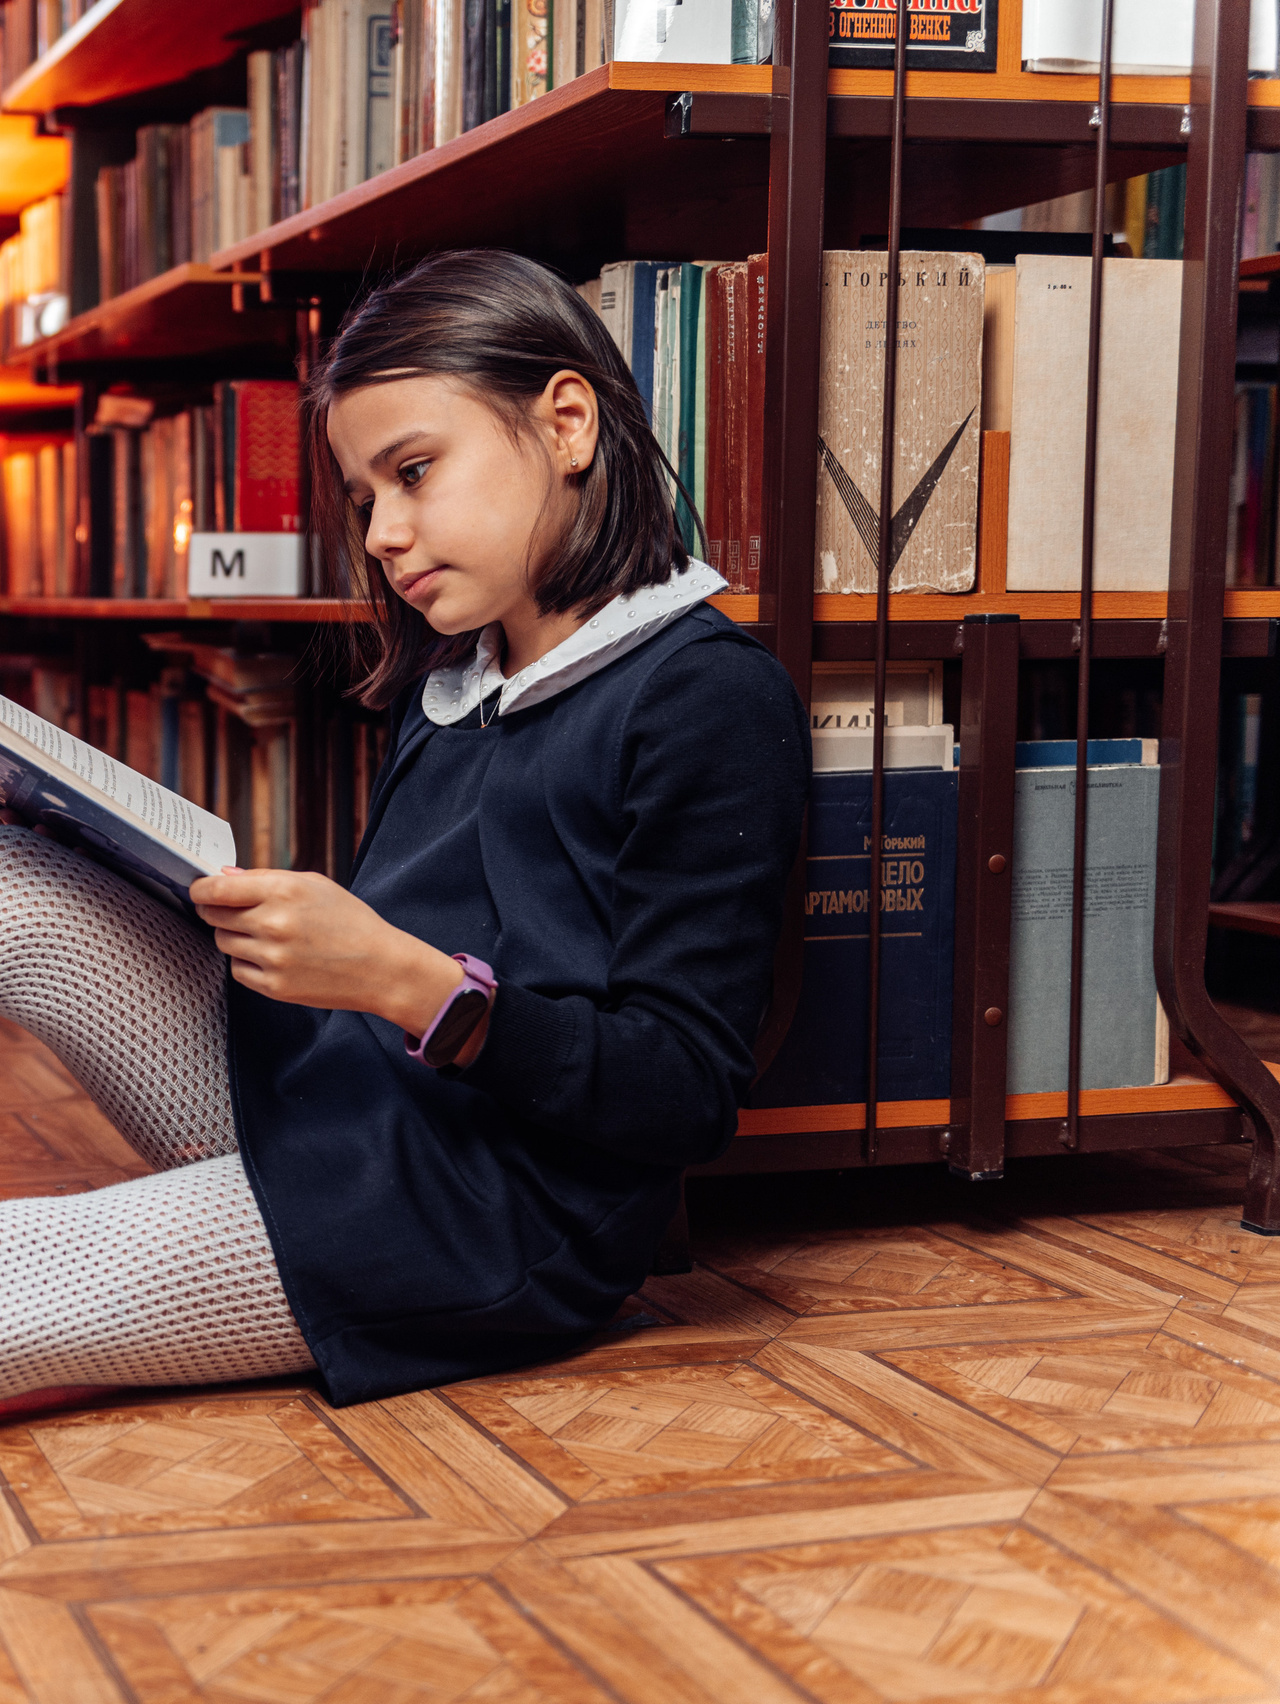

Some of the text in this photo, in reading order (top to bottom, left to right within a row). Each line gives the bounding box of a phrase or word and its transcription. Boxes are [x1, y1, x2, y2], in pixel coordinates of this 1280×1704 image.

[839, 11, 897, 39] ОГНЕННО
[909, 14, 951, 41] ВЕНКЕ
[843, 267, 970, 287] ГОРЬКИЙ
[865, 320, 917, 330] ДЕТТВО
[210, 549, 246, 578] М
